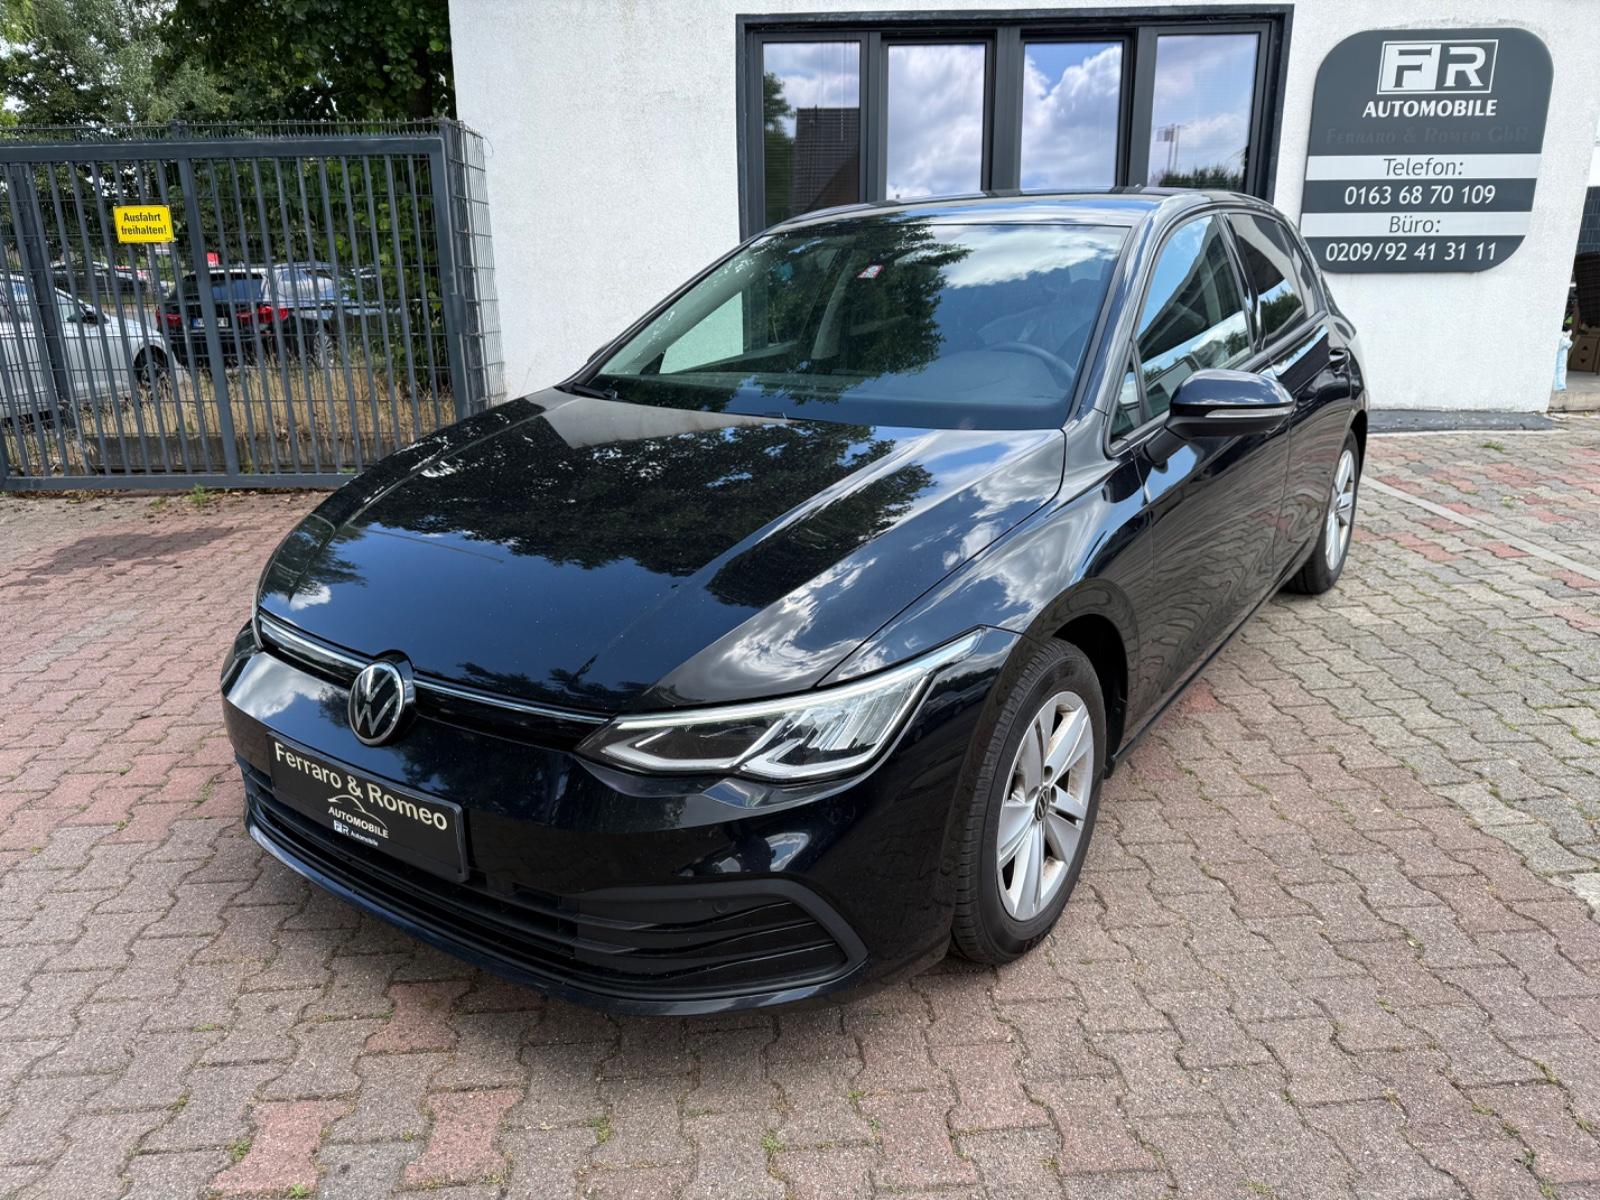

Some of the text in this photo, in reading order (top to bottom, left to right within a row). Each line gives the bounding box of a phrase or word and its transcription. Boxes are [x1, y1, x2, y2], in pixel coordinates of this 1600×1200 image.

[1362, 99, 1498, 119] AUTOMOBILE
[1383, 157, 1464, 177] Telefon:
[1344, 184, 1496, 205] 0163 68 70 109
[123, 212, 162, 222] Ausfahrt
[1389, 215, 1441, 234] Büro:
[121, 224, 168, 235] freihalten!
[1325, 241, 1496, 262] 0209/92 41 31 11
[274, 741, 448, 831] Ferraro & Romeo
[328, 806, 390, 839] AUTOMOBILE
